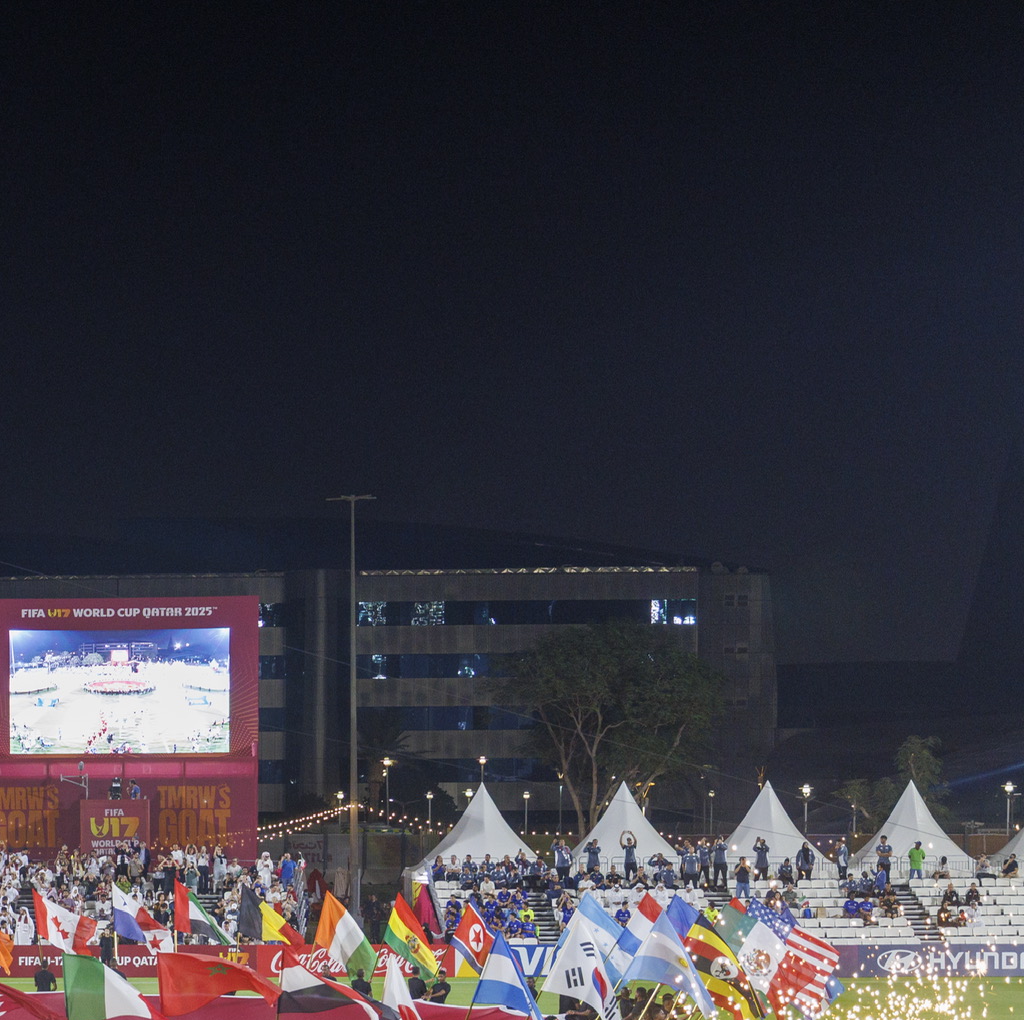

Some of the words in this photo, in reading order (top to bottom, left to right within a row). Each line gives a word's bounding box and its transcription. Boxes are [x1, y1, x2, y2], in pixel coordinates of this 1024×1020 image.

[21, 608, 45, 618] FIFA
[48, 608, 71, 618] U17
[73, 608, 115, 618] WORLD
[117, 608, 140, 617] CUP
[142, 607, 182, 618] QATAR
[104, 808, 124, 816] FIFA
[90, 817, 140, 838] U17
[159, 809, 231, 847] GOAT
[18, 956, 42, 966] FIFA
